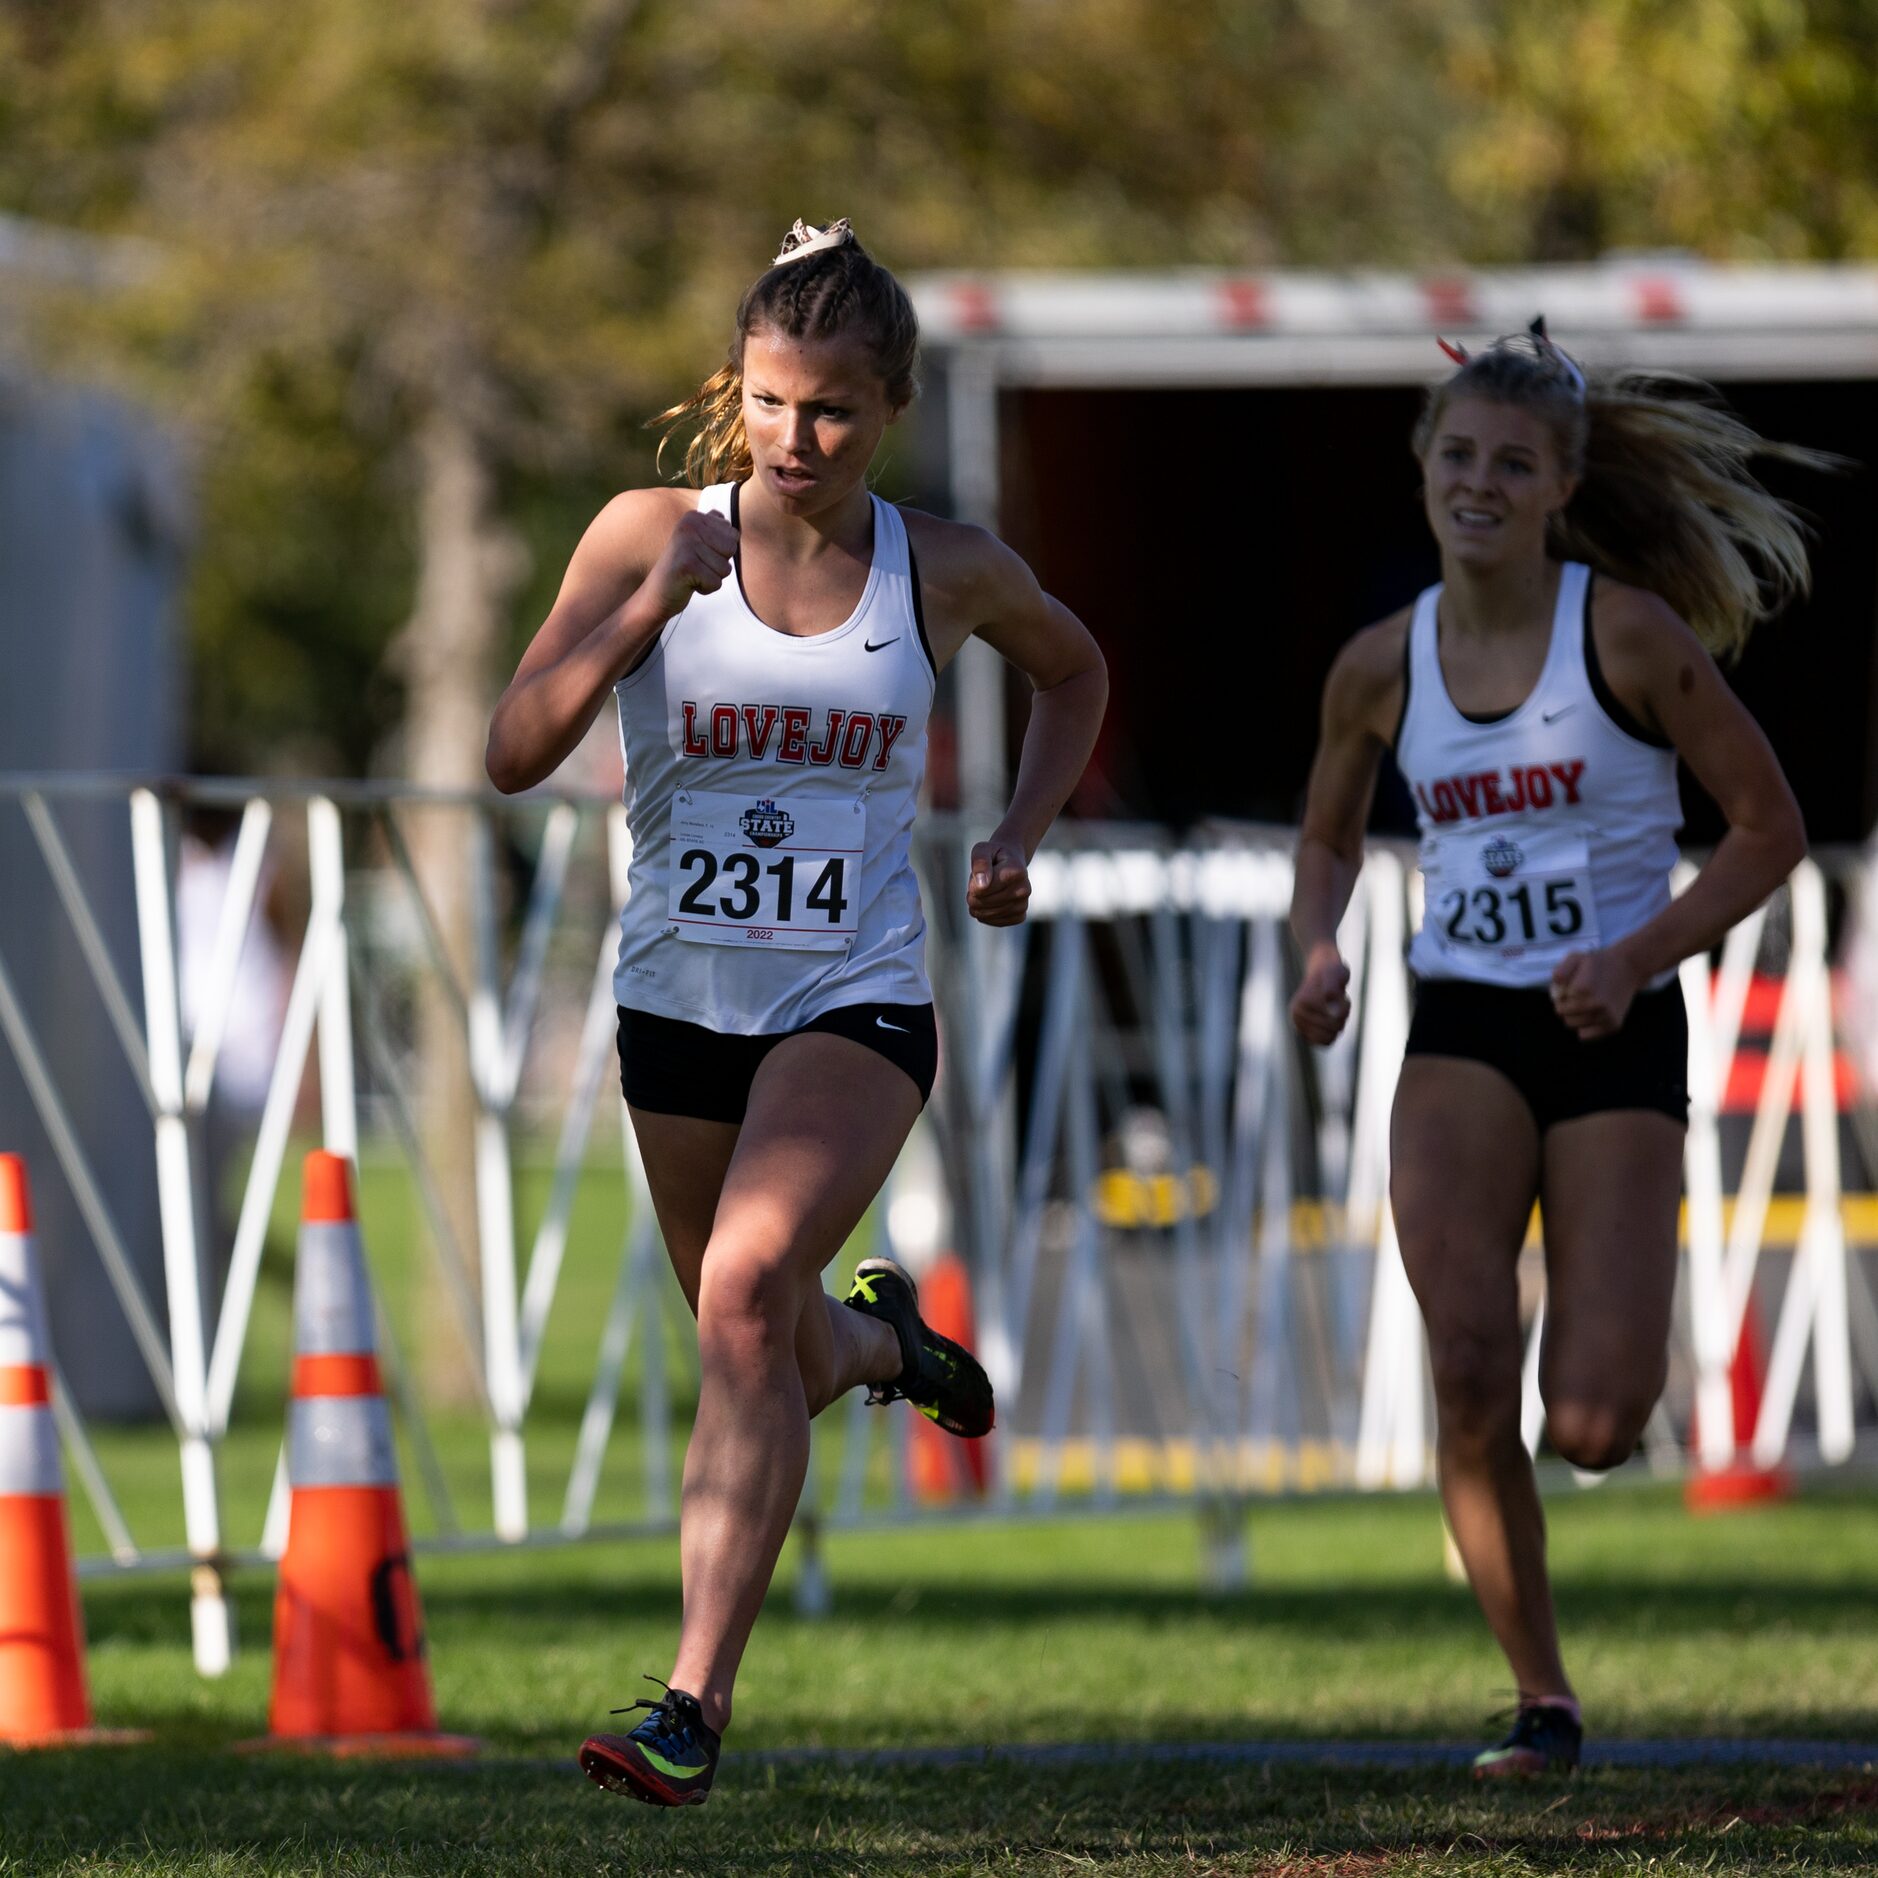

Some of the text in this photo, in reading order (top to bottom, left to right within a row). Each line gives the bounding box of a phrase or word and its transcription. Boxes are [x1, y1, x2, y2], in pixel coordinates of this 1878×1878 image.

[682, 701, 907, 772] LOVEJOY
[1418, 760, 1585, 823] LOVEJOY
[740, 818, 793, 834] STATE
[679, 848, 847, 924] 2314
[1443, 881, 1582, 943] 2315
[746, 929, 774, 941] 2022
